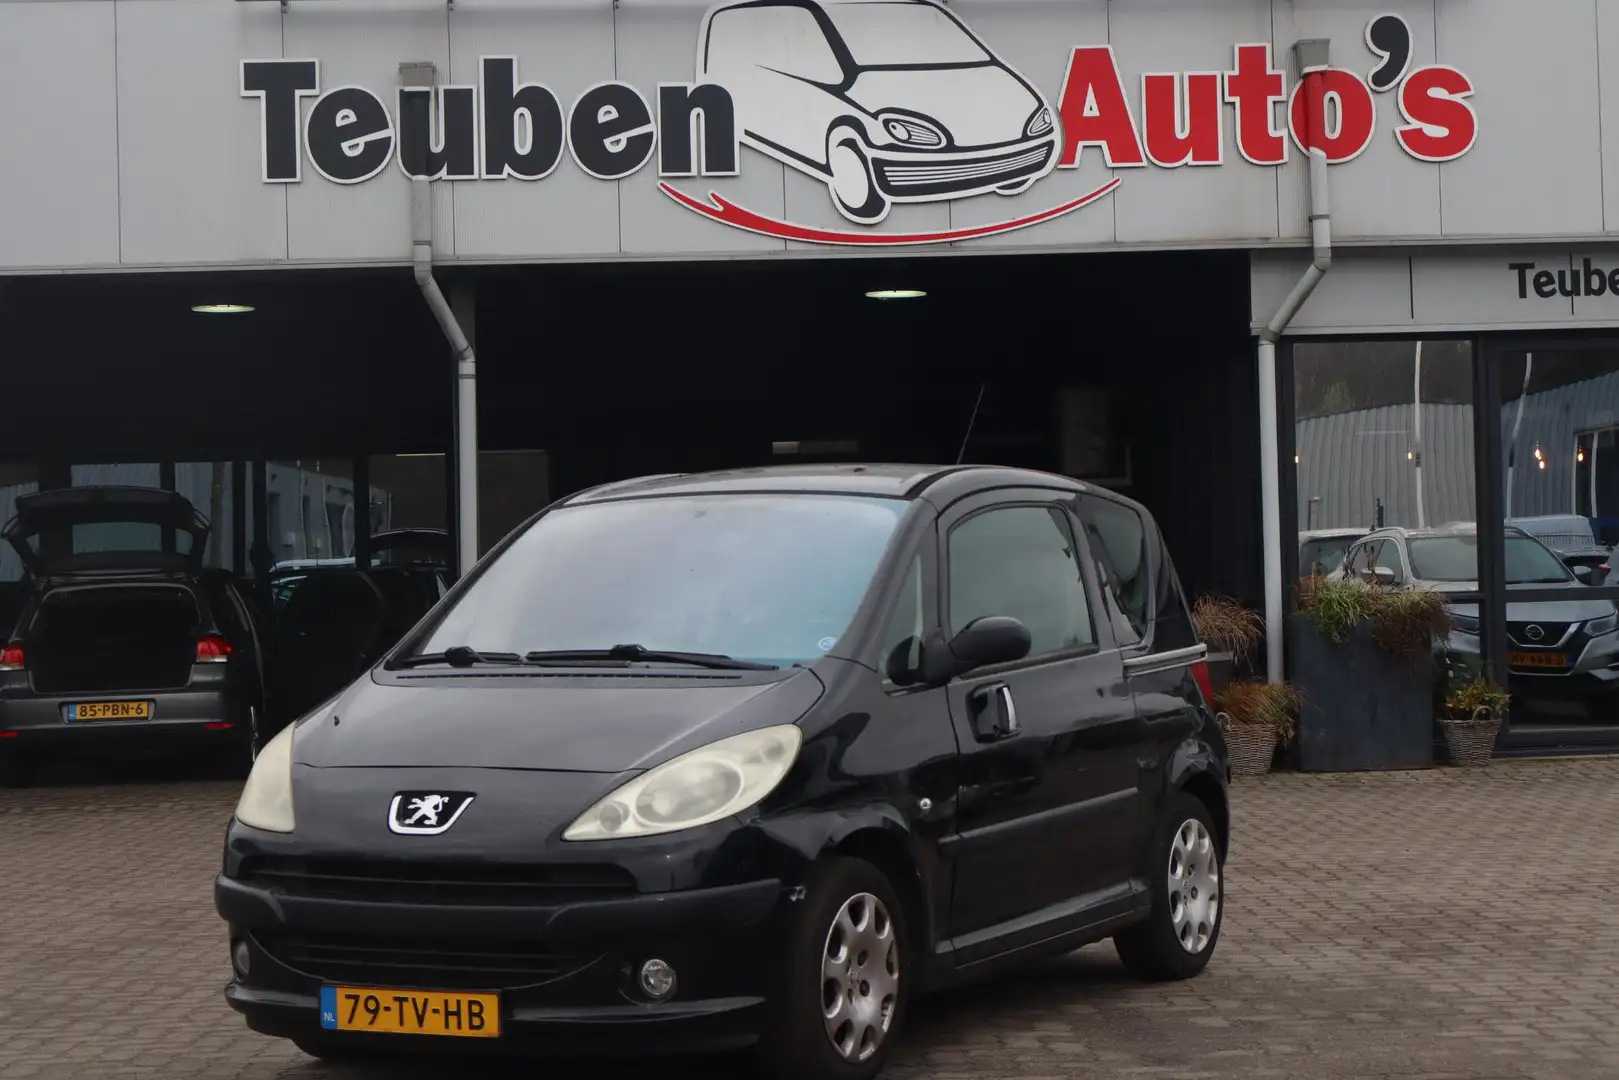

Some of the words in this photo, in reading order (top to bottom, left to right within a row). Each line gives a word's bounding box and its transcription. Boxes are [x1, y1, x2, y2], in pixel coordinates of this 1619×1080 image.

[241, 57, 739, 184] Teuben
[1058, 14, 1478, 168] Auto's
[79, 703, 144, 718] 85-PBN-6
[323, 1011, 336, 1022] NL
[344, 993, 485, 1031] 79-TV-HB
